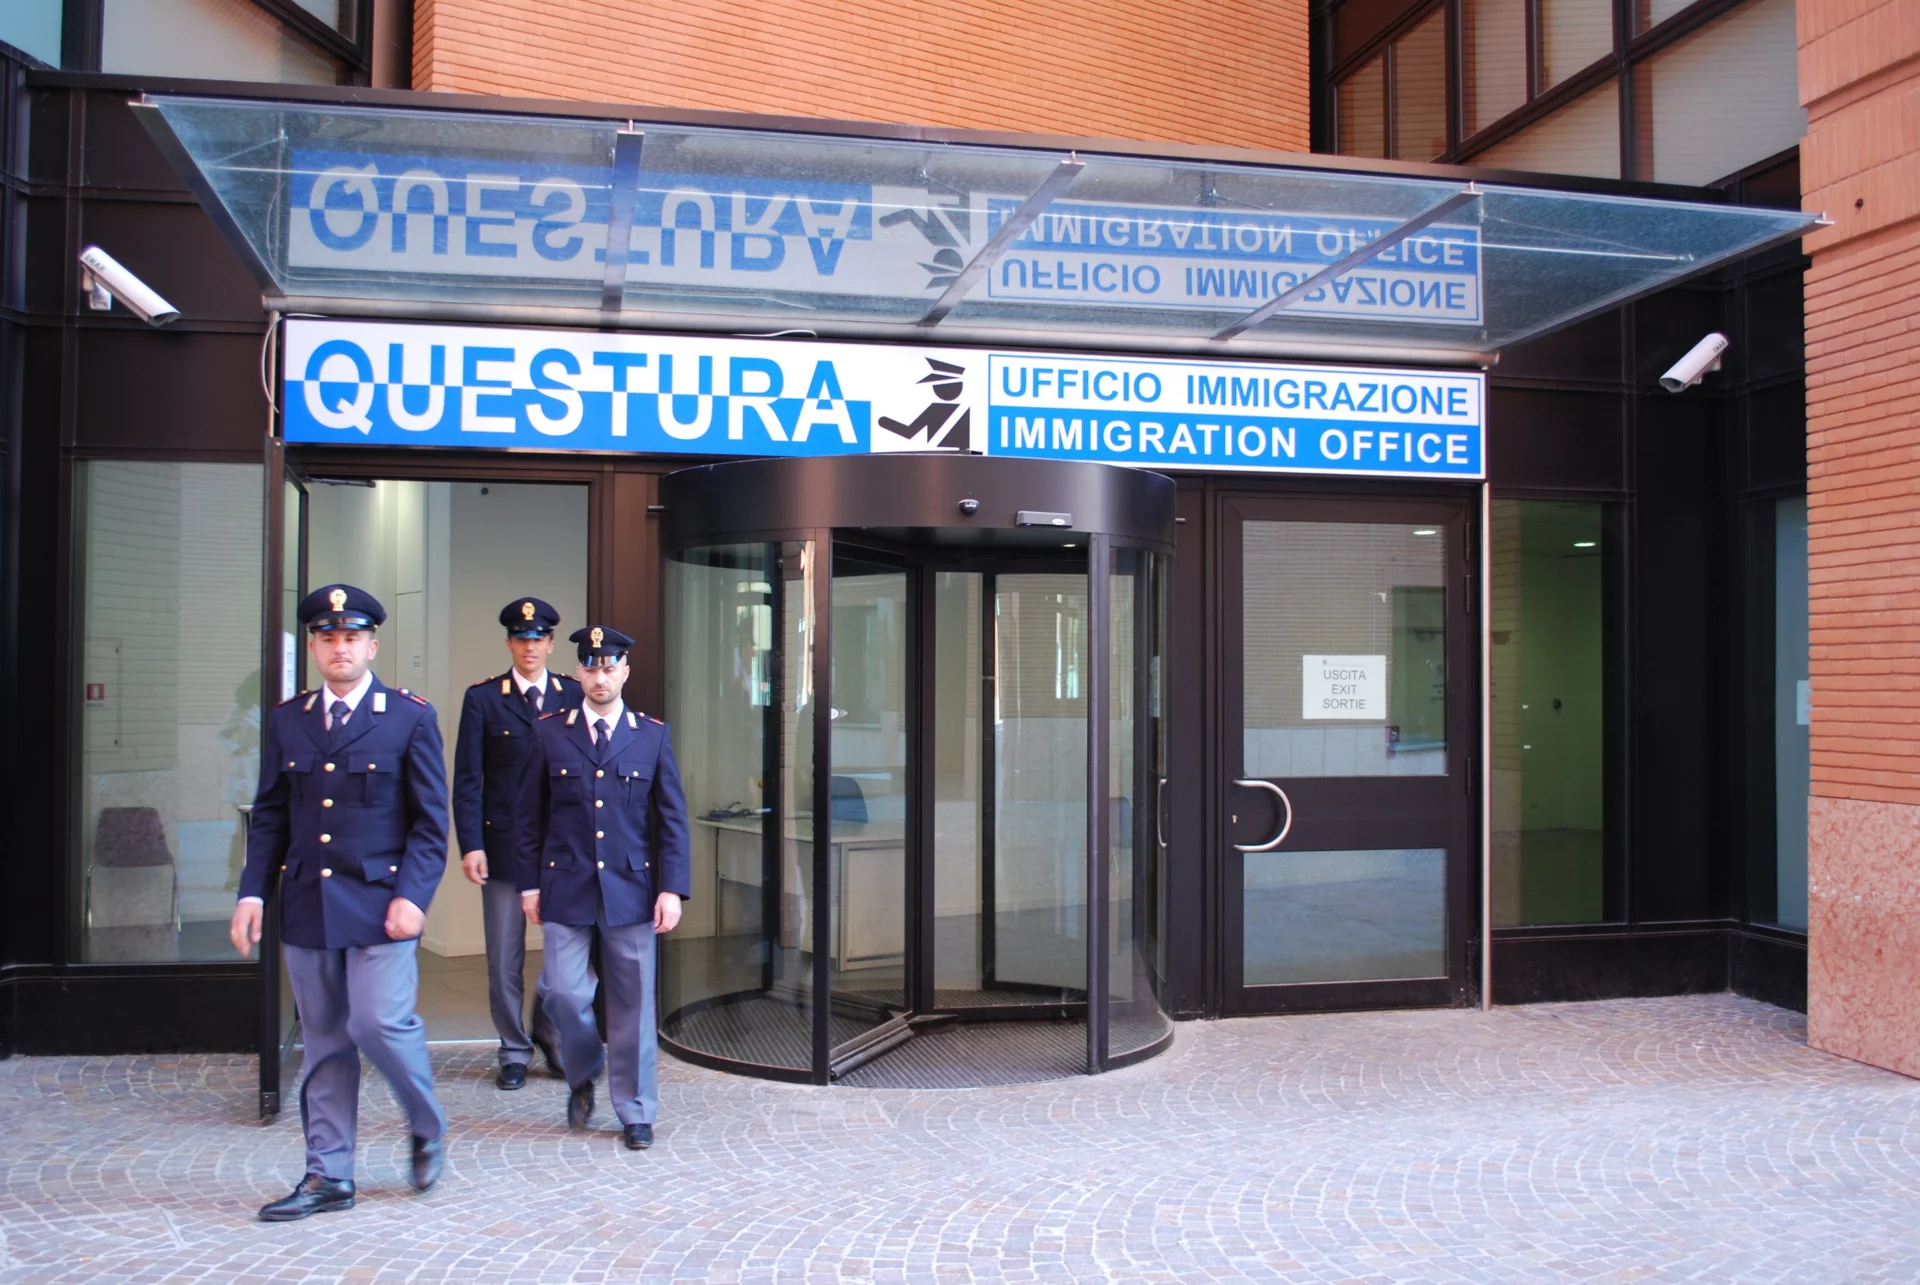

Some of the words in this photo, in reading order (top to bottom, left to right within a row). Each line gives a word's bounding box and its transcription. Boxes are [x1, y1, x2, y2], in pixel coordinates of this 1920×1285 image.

[304, 339, 858, 443] QUESTURA
[1002, 366, 1162, 403] UFFICIO
[1187, 375, 1469, 416] IMMIGRAZIONE
[1000, 416, 1297, 458] IMMIGRATION
[1319, 429, 1469, 464] OFFICE
[1323, 669, 1367, 681] USCITA
[1331, 684, 1358, 695] EXIT
[1322, 698, 1366, 709] SORTIE
